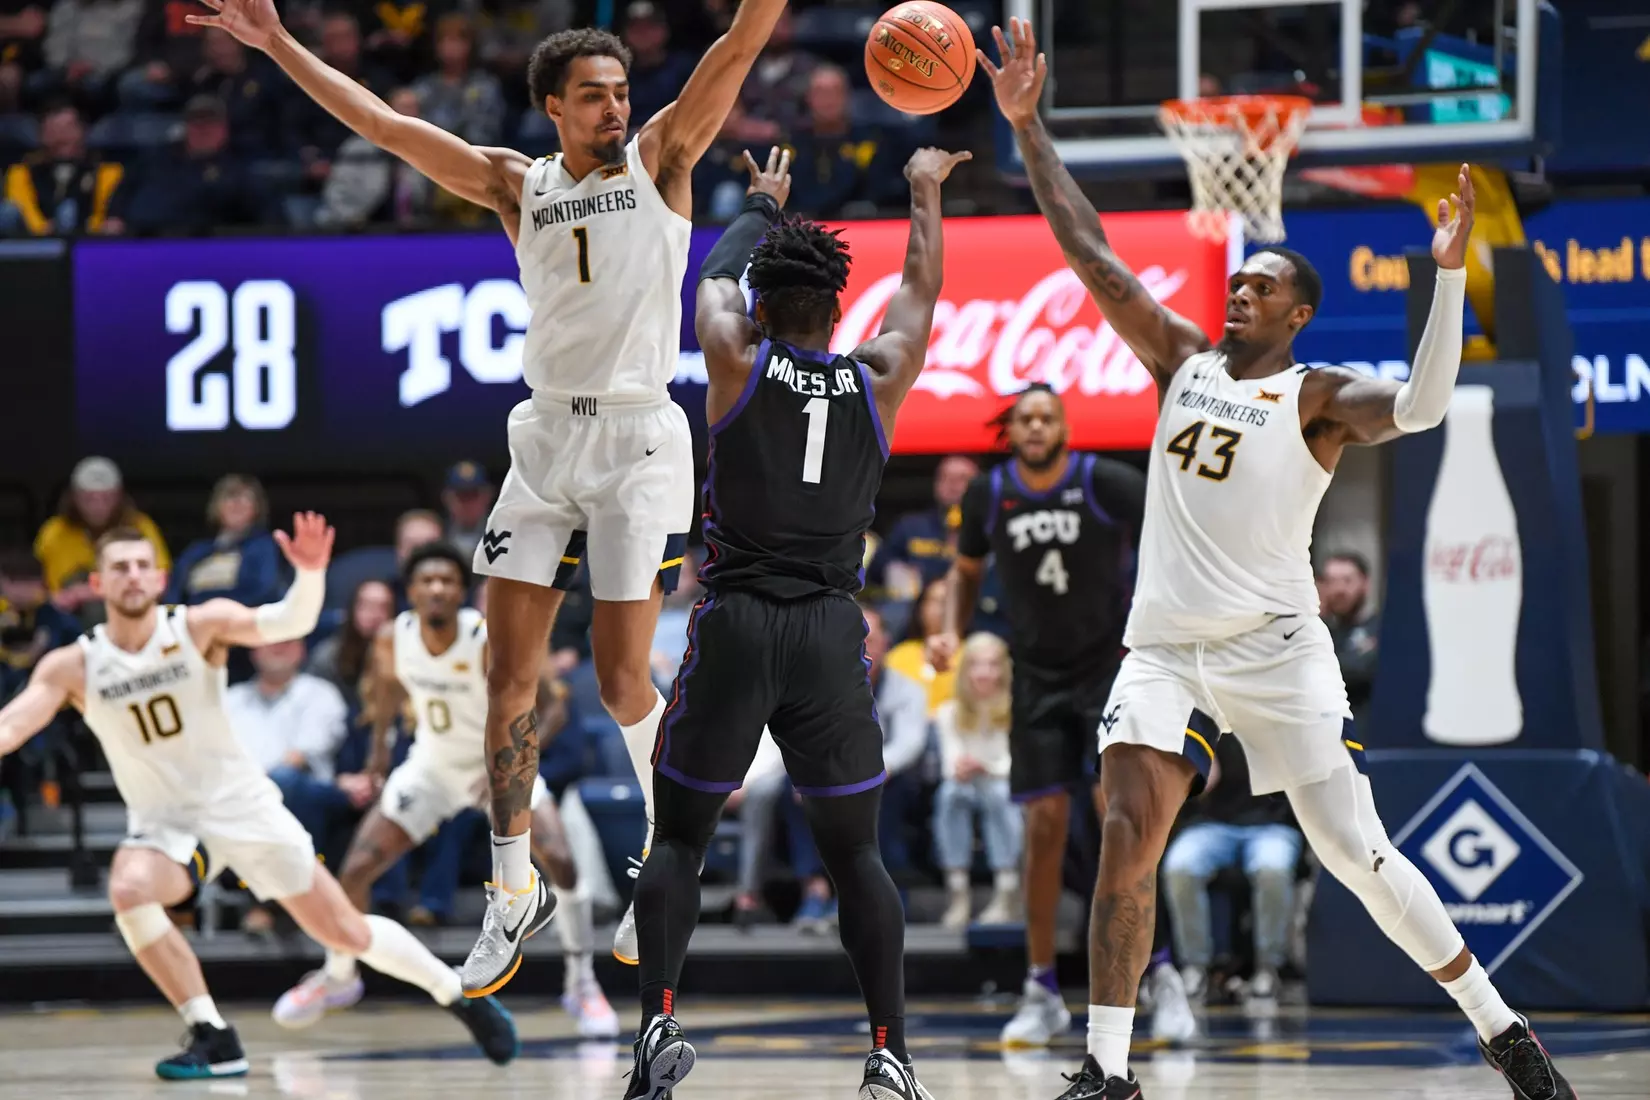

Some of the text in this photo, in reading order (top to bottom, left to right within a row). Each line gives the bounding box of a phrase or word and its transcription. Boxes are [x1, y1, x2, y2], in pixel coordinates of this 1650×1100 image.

[875, 27, 939, 78] SPALDING
[531, 189, 636, 231] MOUNTAINEERS
[572, 225, 591, 285] 1
[165, 280, 296, 432] 28
[381, 279, 532, 408] TC
[766, 354, 860, 396] MILES JR
[571, 396, 597, 416] WVU
[1175, 387, 1270, 427] MOUNTAINEERS
[801, 397, 830, 484] 1
[1166, 419, 1244, 483] 43
[1006, 508, 1082, 552] TCU
[1035, 548, 1070, 595] 4
[128, 693, 184, 745] 10
[427, 698, 453, 734] 0
